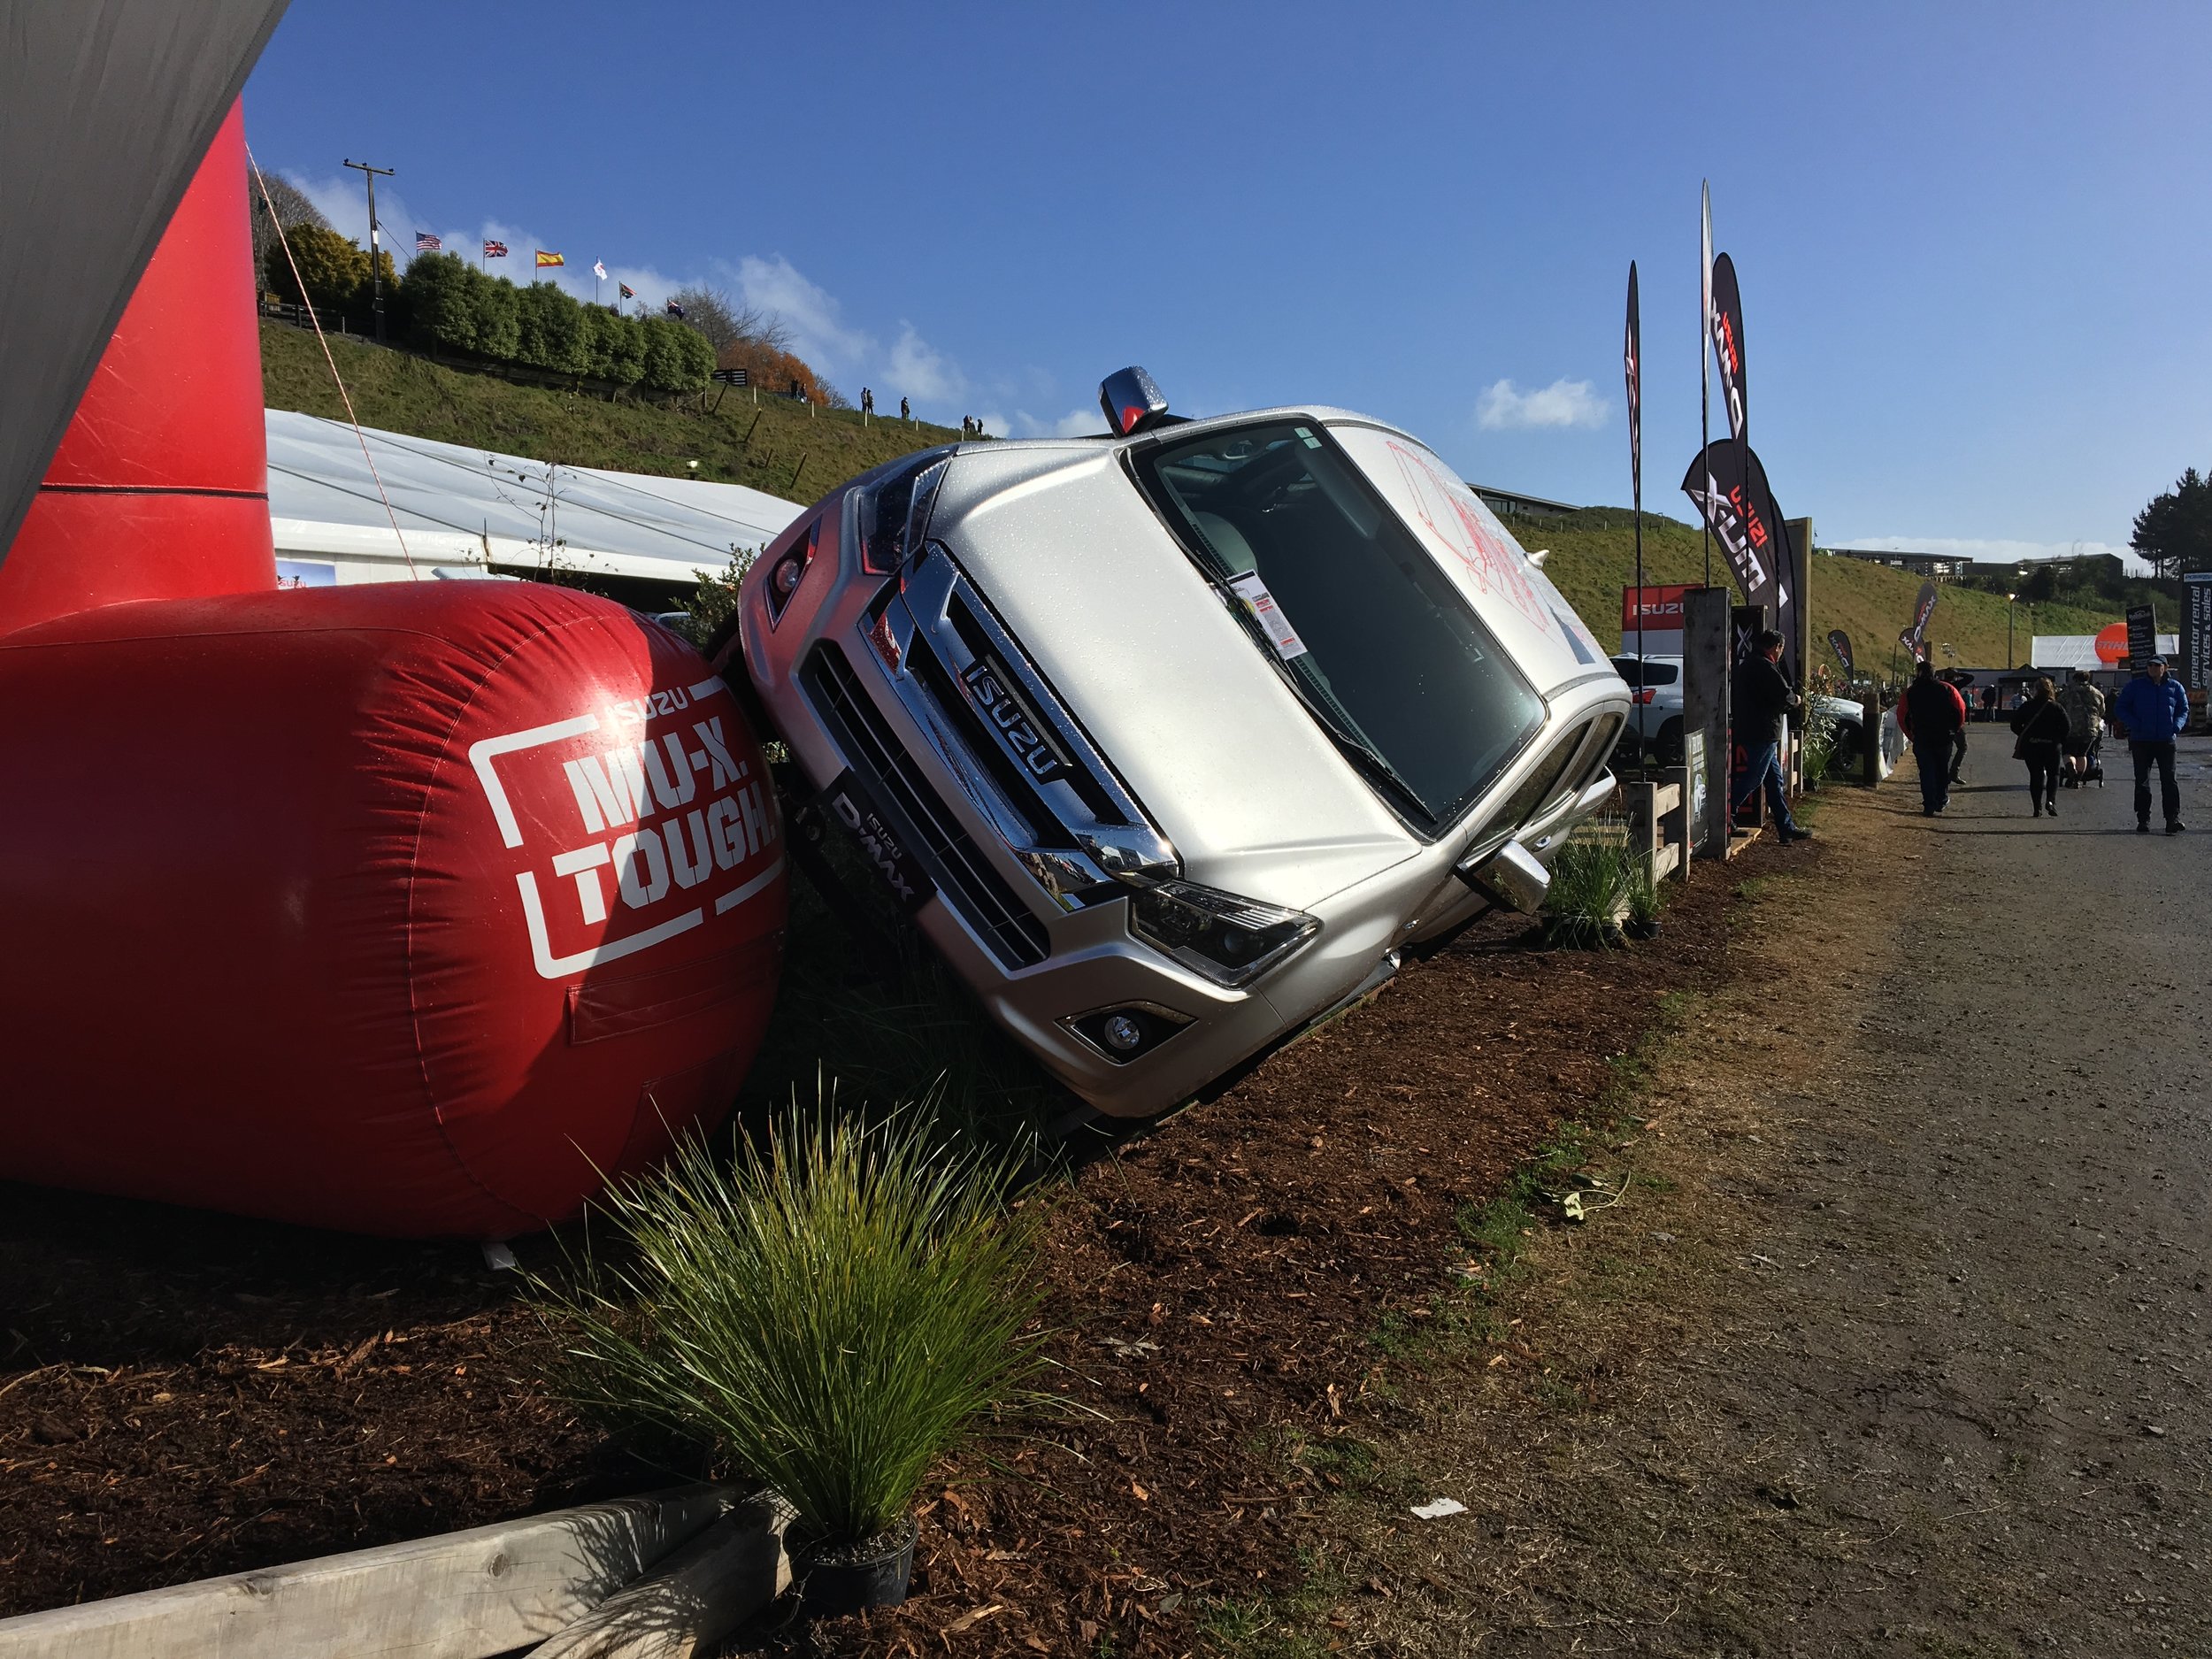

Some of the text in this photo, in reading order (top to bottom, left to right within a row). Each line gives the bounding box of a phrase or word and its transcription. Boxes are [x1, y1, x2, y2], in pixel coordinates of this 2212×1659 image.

[1632, 603, 1684, 616] ISUZ
[2191, 586, 2200, 689] generator rental
[2201, 588, 2211, 620] sales
[605, 687, 688, 727] ISUZU
[965, 664, 1057, 774] ISUZU
[551, 780, 777, 926] TOUGH.
[832, 792, 915, 902] D-MAX
[867, 813, 902, 859] ISUZU
